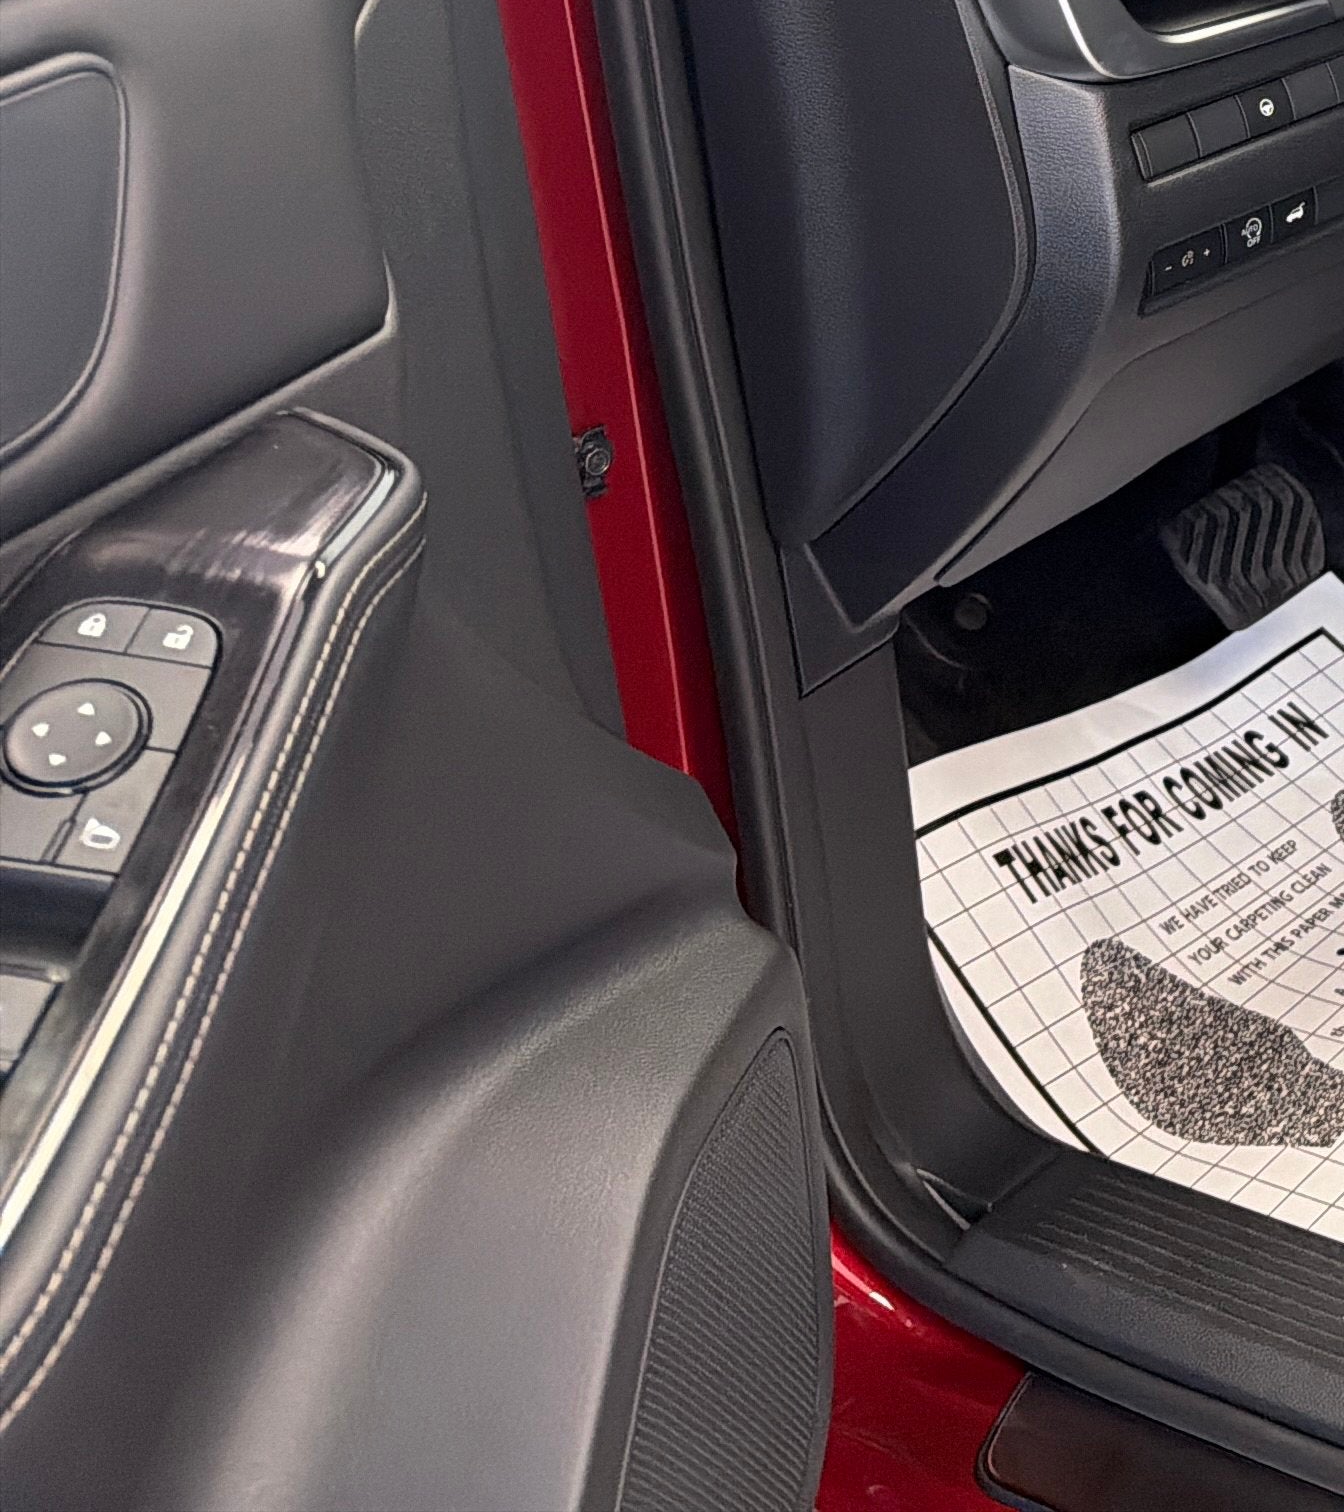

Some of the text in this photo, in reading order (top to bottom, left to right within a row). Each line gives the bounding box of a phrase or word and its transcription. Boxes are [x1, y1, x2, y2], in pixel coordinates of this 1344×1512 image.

[992, 702, 1330, 904] THANKS FOR COMING IN
[1158, 839, 1297, 935] WE HAVE TRIED TO KEEP
[1187, 862, 1332, 965] YOUR CARPETING CLEAN
[1227, 958, 1268, 986] WITH
[1261, 936, 1295, 960] THIS
[1290, 907, 1332, 940] PAPER
